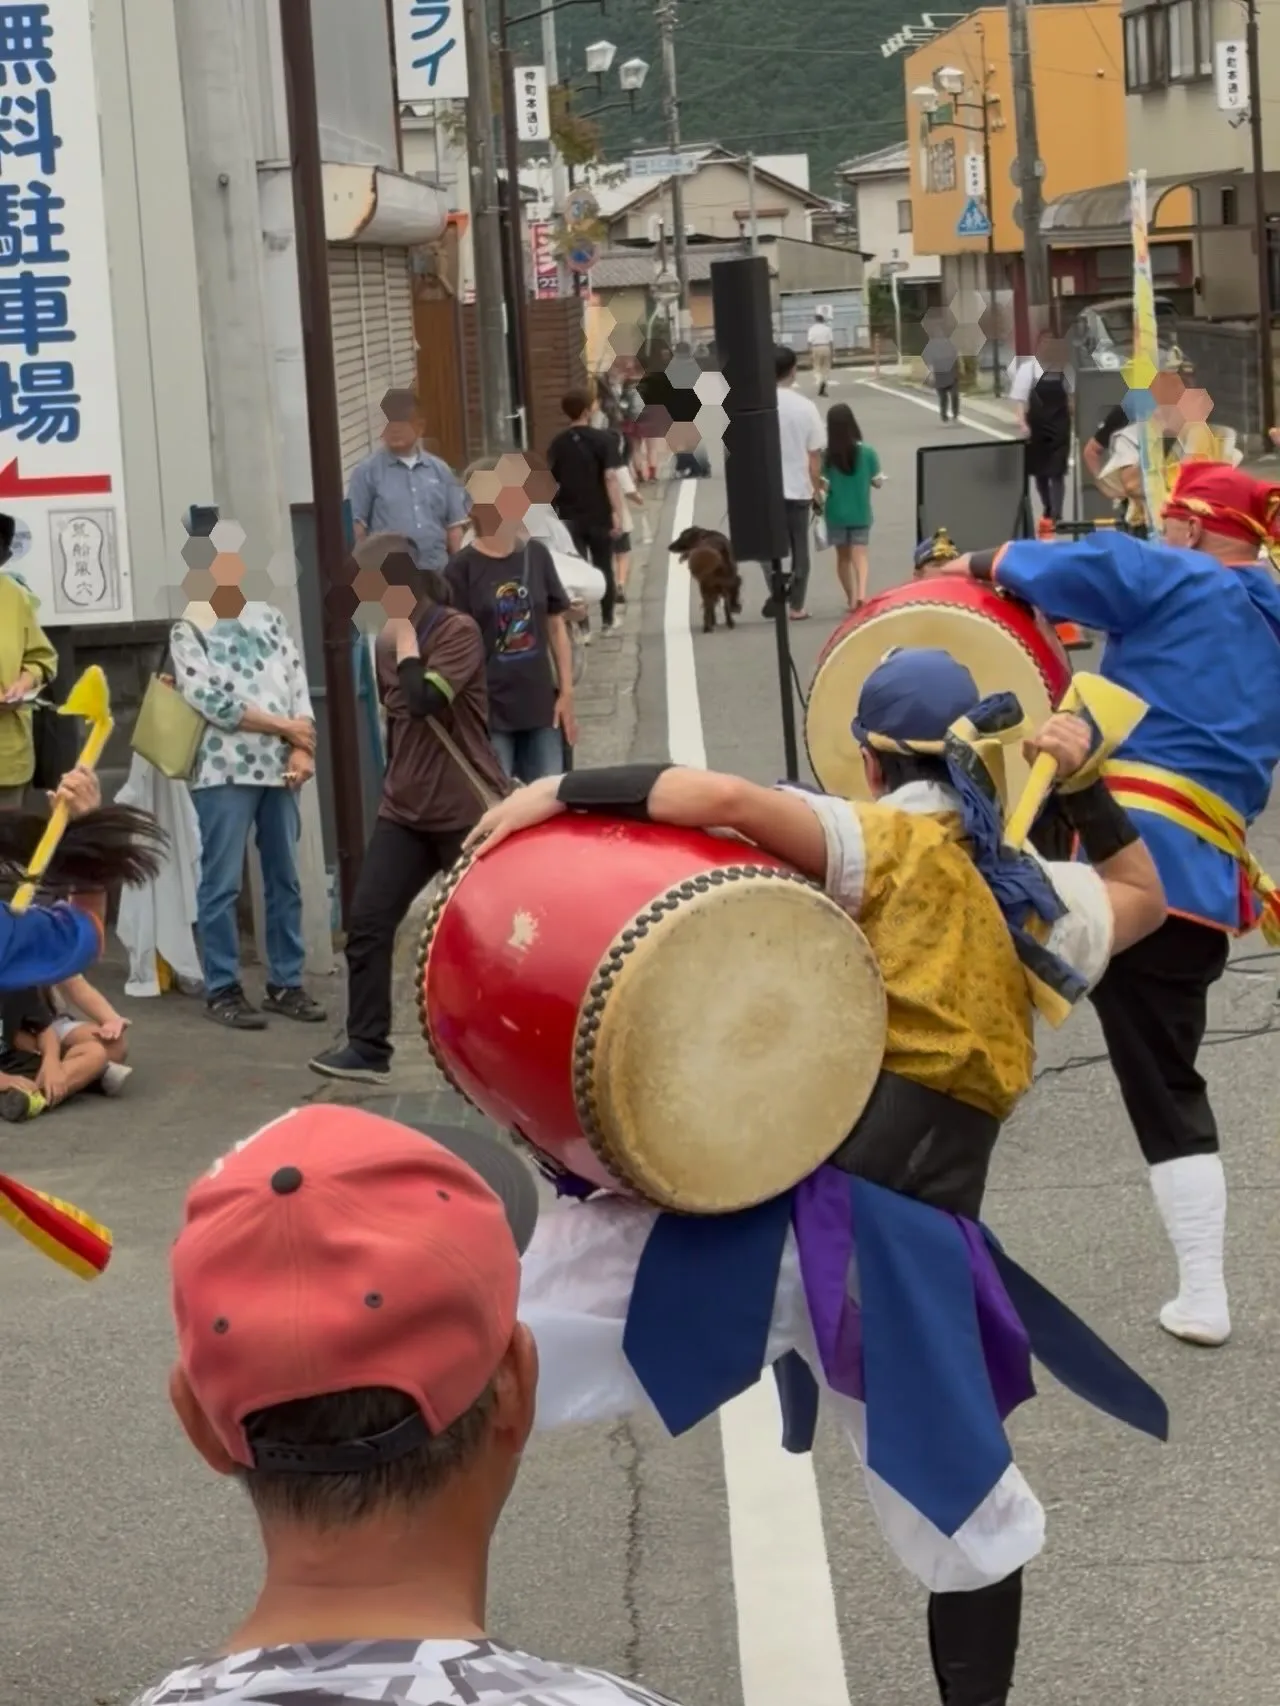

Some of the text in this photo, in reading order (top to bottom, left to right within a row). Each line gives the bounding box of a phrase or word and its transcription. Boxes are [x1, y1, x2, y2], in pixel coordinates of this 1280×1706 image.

[410, 0, 456, 87] ライ
[0, 3, 81, 444] 無料駐車場
